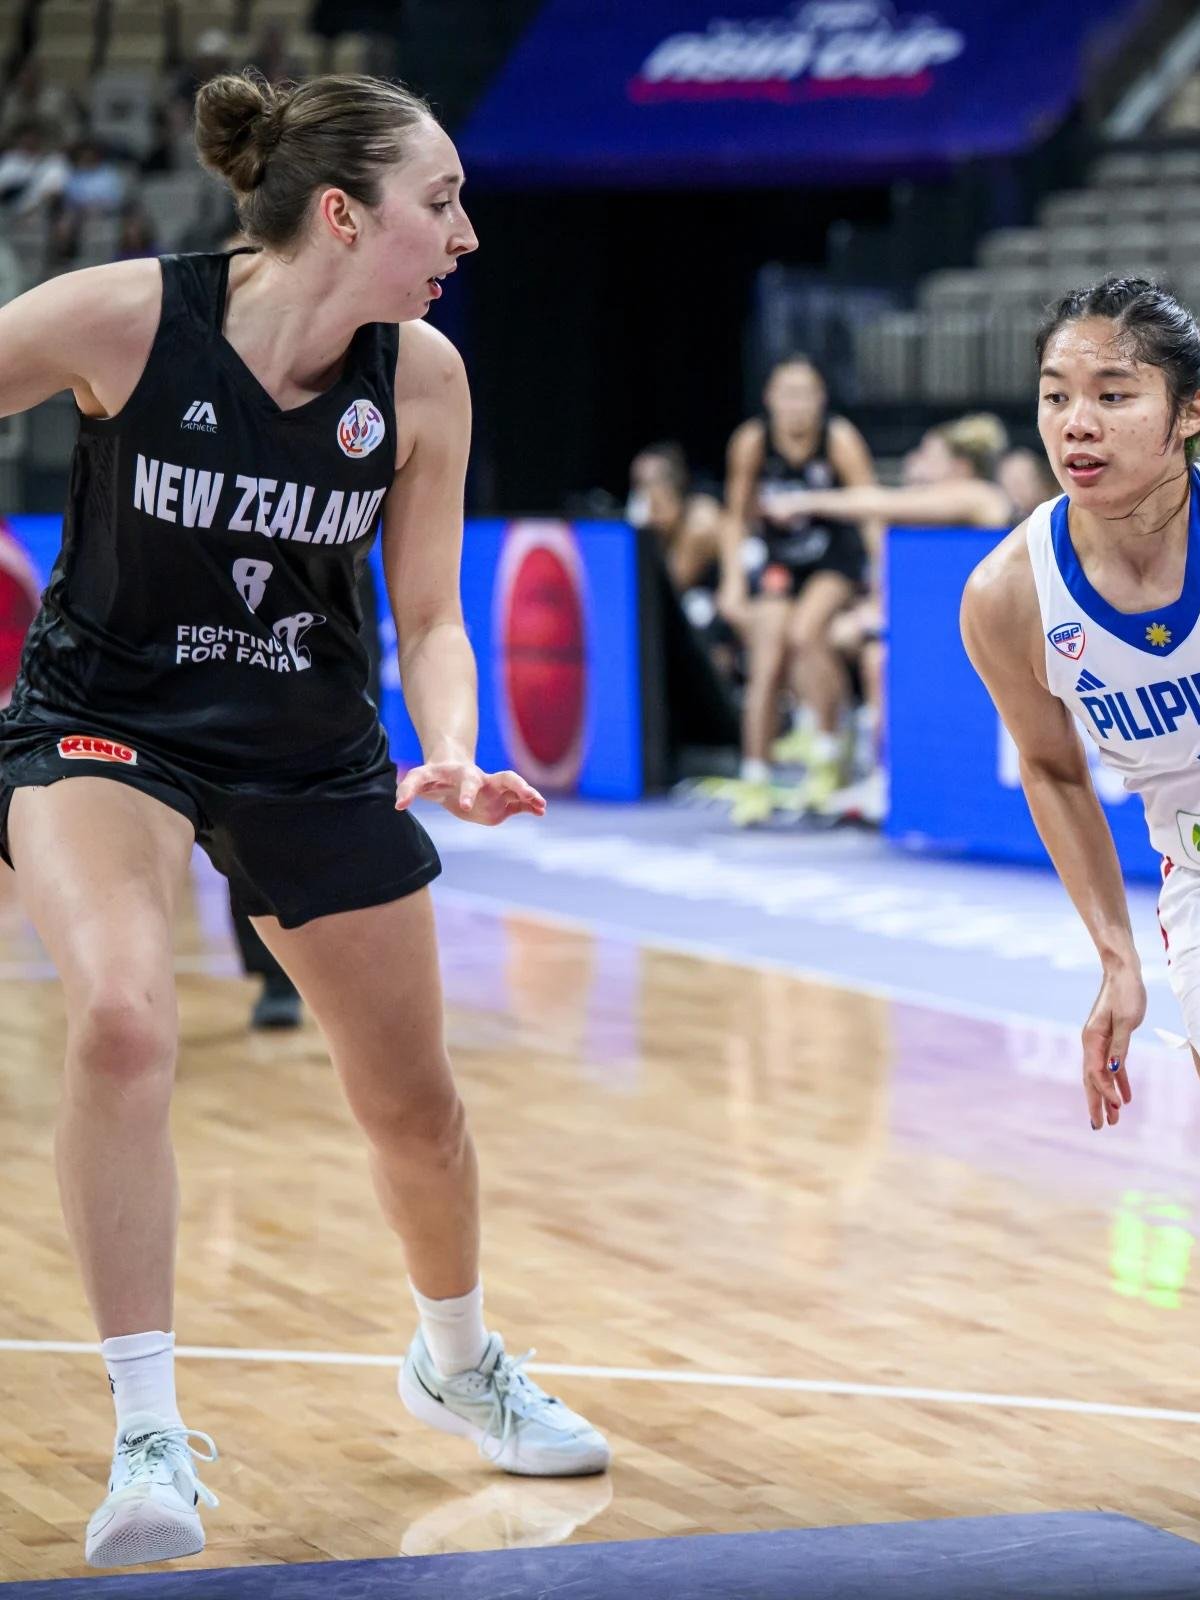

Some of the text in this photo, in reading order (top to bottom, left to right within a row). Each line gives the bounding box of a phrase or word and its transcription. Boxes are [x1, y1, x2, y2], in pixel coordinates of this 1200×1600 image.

[133, 453, 387, 545] NEW ZEALAND
[232, 557, 274, 615] 8
[177, 625, 283, 655] FIGHTING
[176, 643, 291, 673] FOR FAIR
[60, 738, 134, 761] KING
